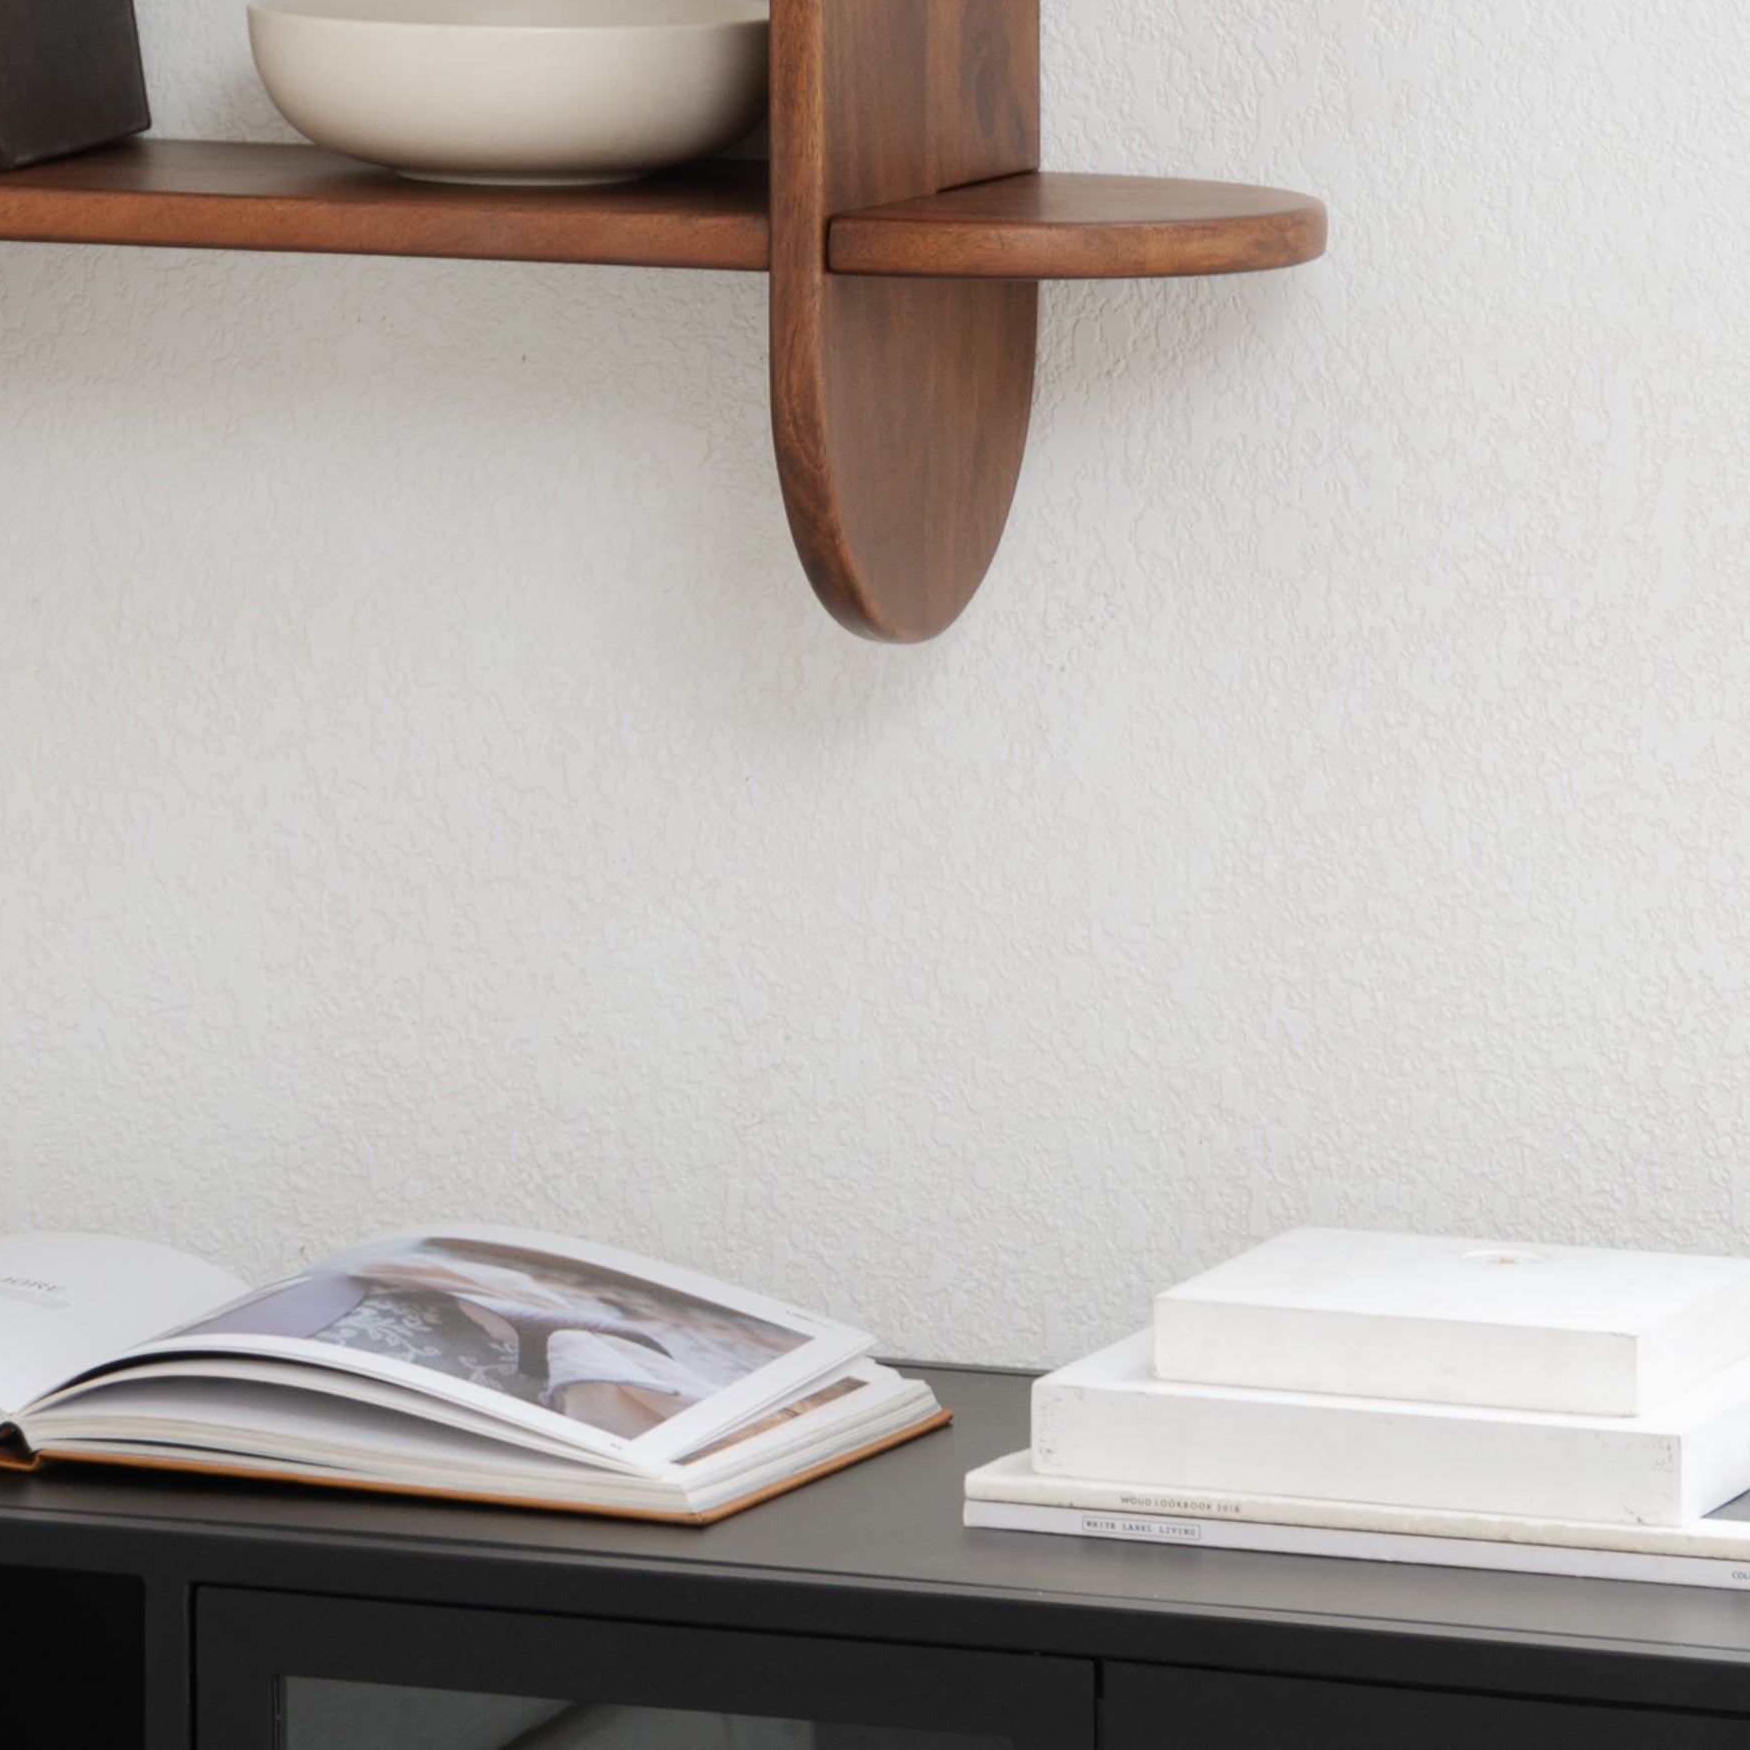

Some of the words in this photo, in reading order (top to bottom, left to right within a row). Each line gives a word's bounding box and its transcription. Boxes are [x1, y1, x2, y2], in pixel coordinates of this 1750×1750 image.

[1085, 1520, 1116, 1530] WHITE
[1122, 1523, 1152, 1533] LABEL
[1159, 1526, 1197, 1536] LIVING
